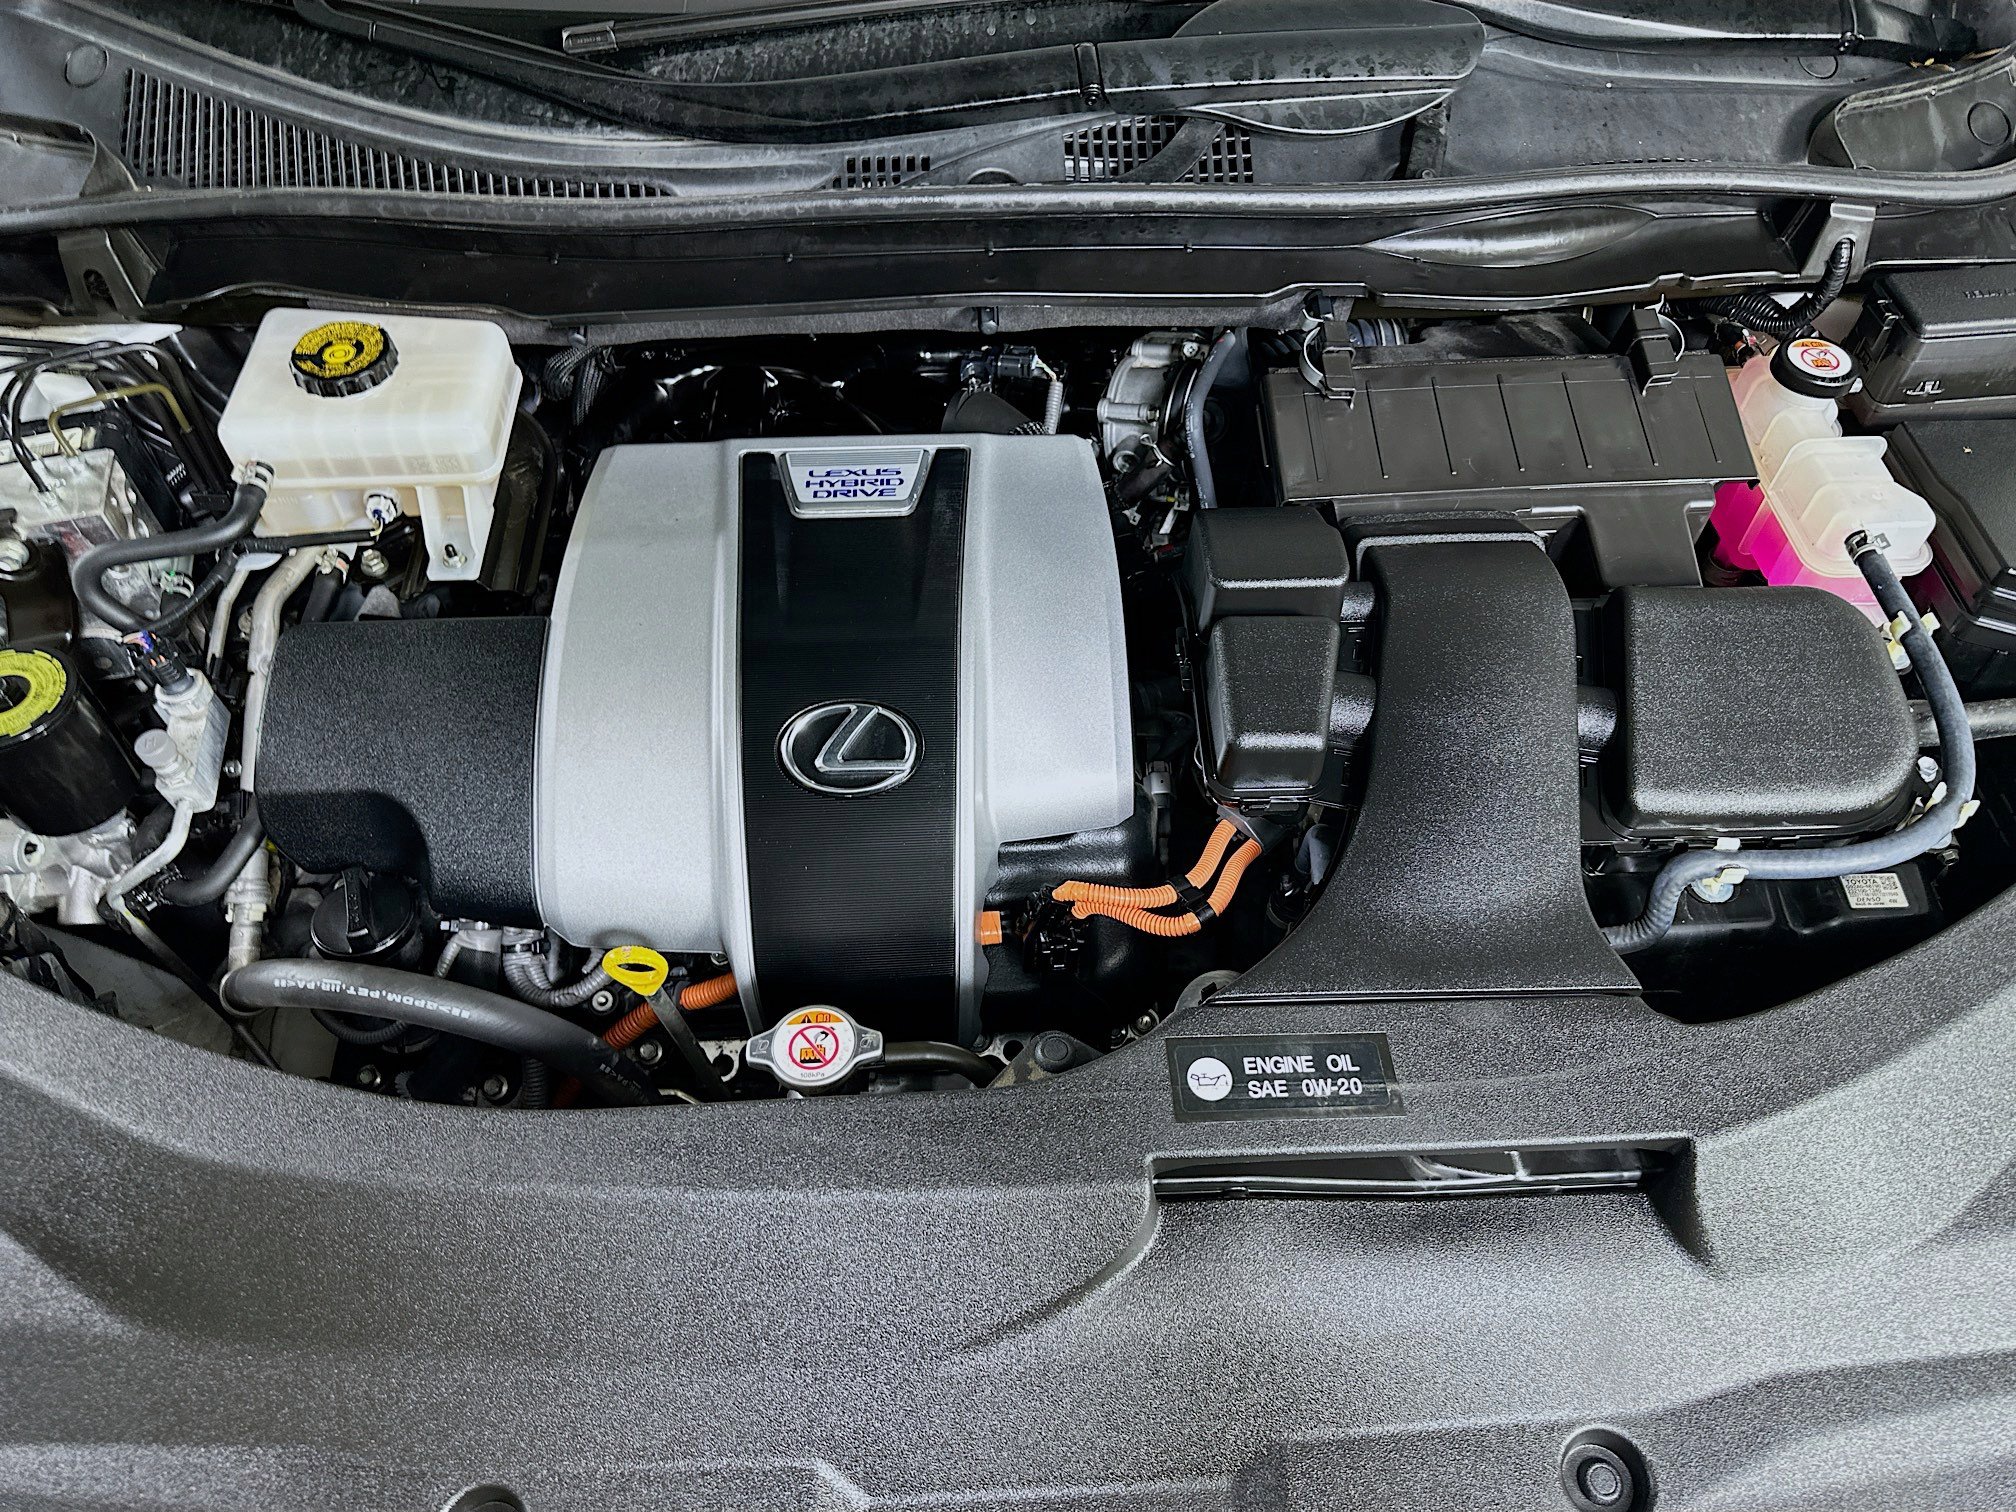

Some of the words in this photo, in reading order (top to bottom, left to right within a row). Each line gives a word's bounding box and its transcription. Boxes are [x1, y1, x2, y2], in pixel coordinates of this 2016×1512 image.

[809, 468, 901, 477] LEXUS
[806, 478, 904, 488] HYBRID
[813, 488, 896, 498] DRIVE
[1243, 1056, 1315, 1074] ENGINE
[1326, 1054, 1360, 1072] OIL
[1248, 1080, 1289, 1098] SAE
[1301, 1078, 1363, 1097] 0W-20
